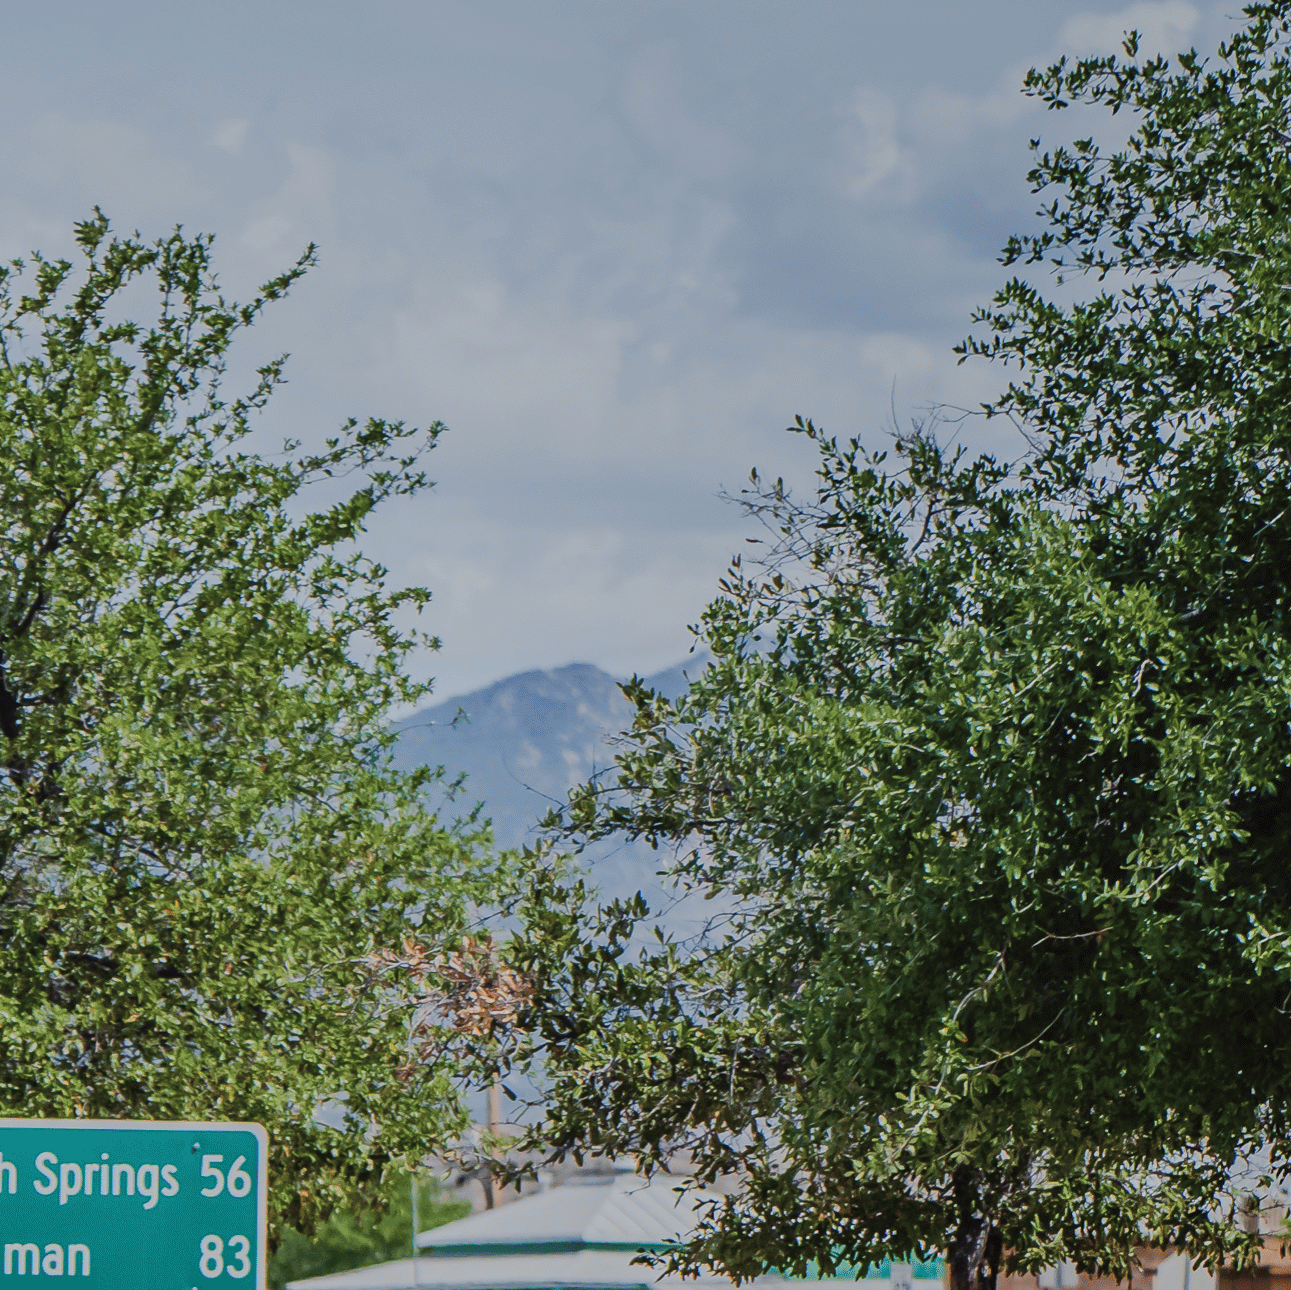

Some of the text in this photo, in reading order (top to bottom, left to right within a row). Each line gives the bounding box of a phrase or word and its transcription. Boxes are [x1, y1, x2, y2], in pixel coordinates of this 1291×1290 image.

[33, 1151, 180, 1210] Springs
[200, 1154, 252, 1198] 56
[199, 1234, 251, 1279] 83
